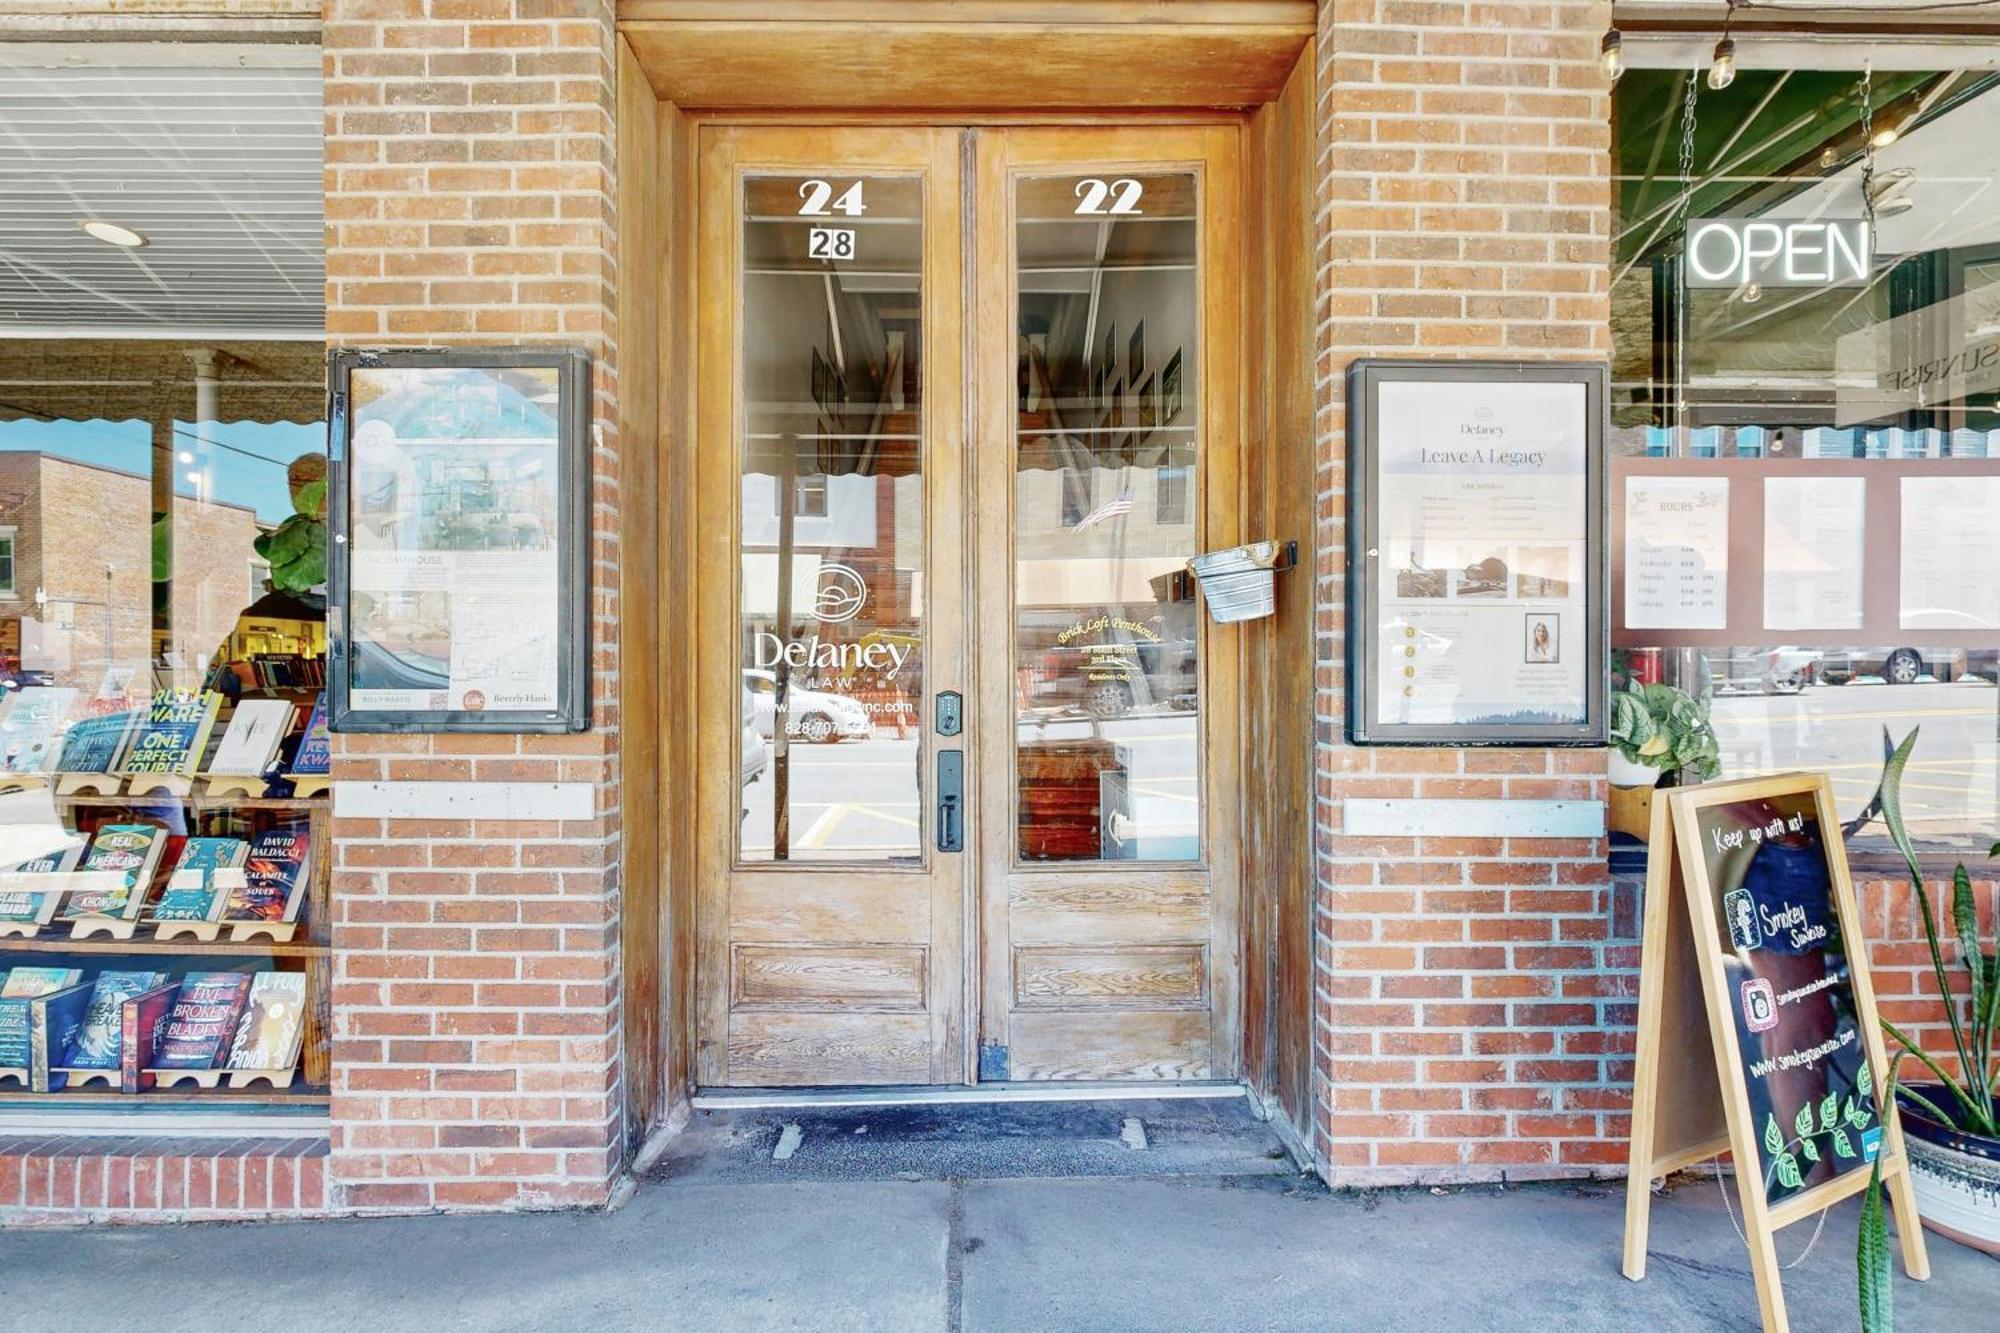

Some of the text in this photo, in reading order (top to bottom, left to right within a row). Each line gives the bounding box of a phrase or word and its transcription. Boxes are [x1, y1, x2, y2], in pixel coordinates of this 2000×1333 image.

[798, 180, 867, 216] 24
[1073, 178, 1143, 214] 22
[812, 230, 852, 257] 28
[1689, 221, 1869, 283] OPEN
[1421, 448, 1547, 468] Leave A Legacy
[1659, 502, 1694, 512] HOURS
[1057, 622, 1085, 644] Brick
[1084, 615, 1109, 633] Loft
[754, 632, 911, 681] Delaney
[811, 677, 852, 689] LAW
[148, 705, 203, 723] WARE
[144, 732, 182, 748] ONE
[130, 750, 190, 762] PERFECT
[300, 753, 330, 766] KWA
[127, 762, 186, 773] COUPLE
[1712, 811, 1804, 853] Keep up with us!
[111, 836, 133, 848] REAL
[263, 837, 296, 846] DAVID
[251, 848, 300, 857] BALDACCI
[26, 859, 55, 872] EVER
[87, 855, 140, 867] AMERICANS
[245, 871, 288, 880] CALAMITY
[246, 888, 275, 896] SOULS
[1760, 902, 1808, 937] Smokey
[192, 988, 225, 999] FIVE
[173, 1004, 230, 1018] BROKEN
